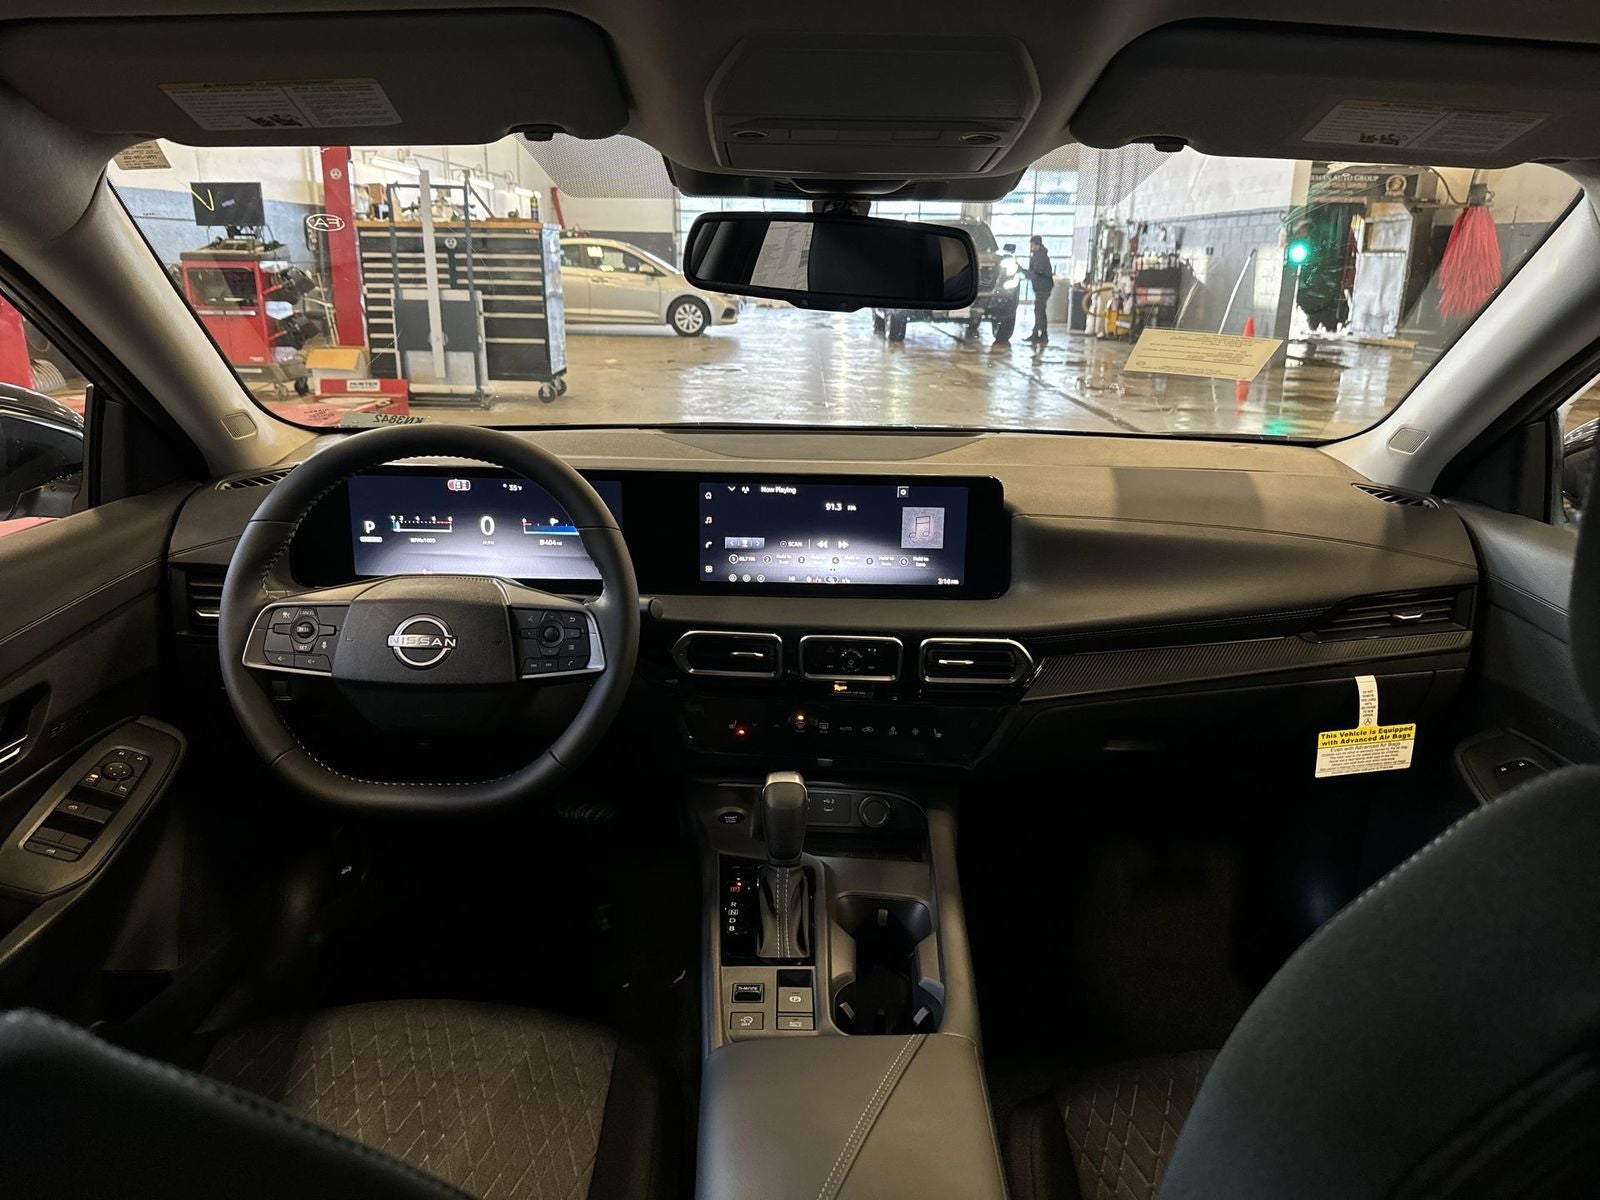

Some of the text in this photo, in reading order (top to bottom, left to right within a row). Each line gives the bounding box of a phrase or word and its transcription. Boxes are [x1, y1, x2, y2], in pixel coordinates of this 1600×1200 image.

[761, 486, 797, 495] Now Playing
[825, 503, 842, 511] 91.3
[363, 520, 376, 534] P
[480, 515, 495, 536] 0
[389, 636, 457, 648] NISSAN
[1321, 732, 1337, 740] This
[1340, 730, 1367, 738] Vehicle
[1378, 725, 1413, 736] Equipped
[1322, 739, 1338, 747] with
[1340, 736, 1377, 745] Advanced
[1392, 732, 1411, 741] Bags
